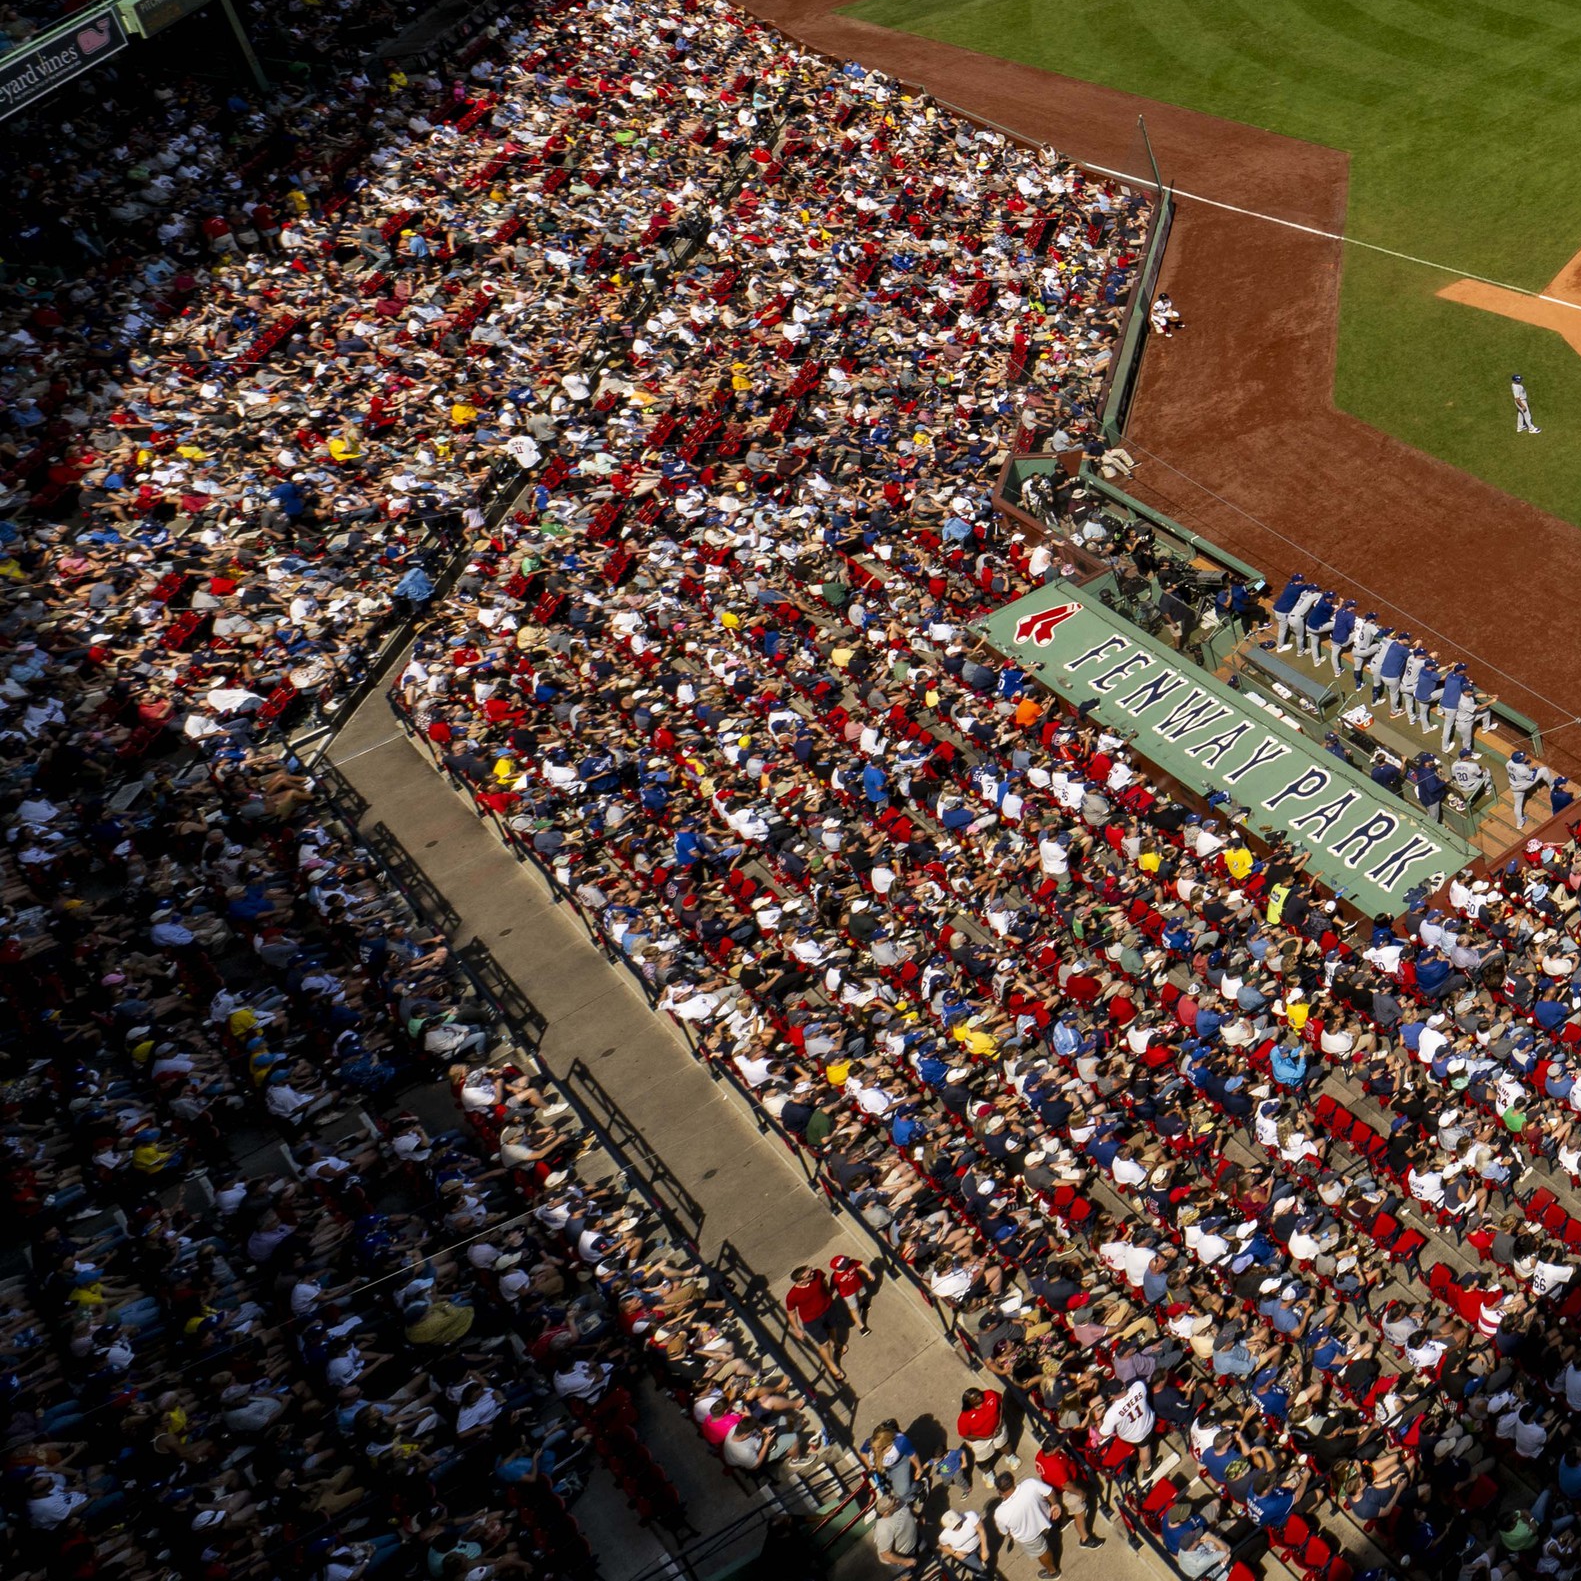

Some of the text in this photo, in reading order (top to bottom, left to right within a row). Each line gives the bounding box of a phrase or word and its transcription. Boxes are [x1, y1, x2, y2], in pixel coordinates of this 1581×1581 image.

[35, 46, 78, 77] vines
[1064, 633, 1443, 893] FENWAY PARK
